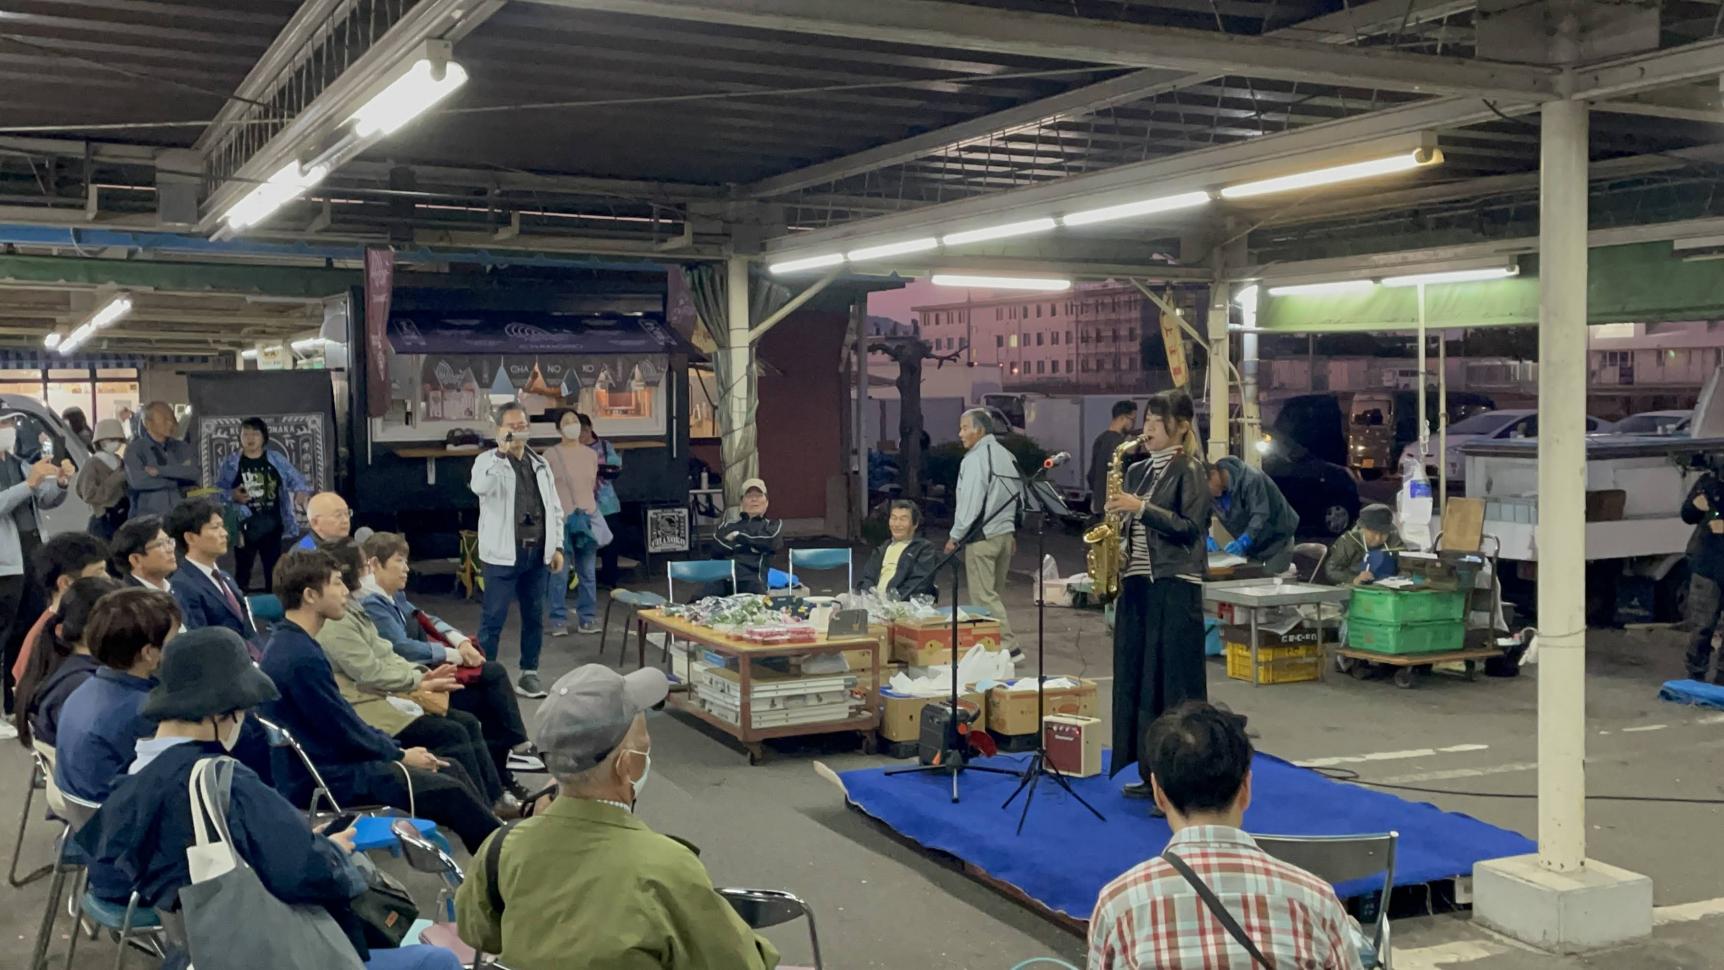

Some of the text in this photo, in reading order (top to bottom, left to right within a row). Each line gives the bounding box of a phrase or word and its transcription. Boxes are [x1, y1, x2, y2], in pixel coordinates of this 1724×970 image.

[510, 364, 595, 374] CHA NO KO
